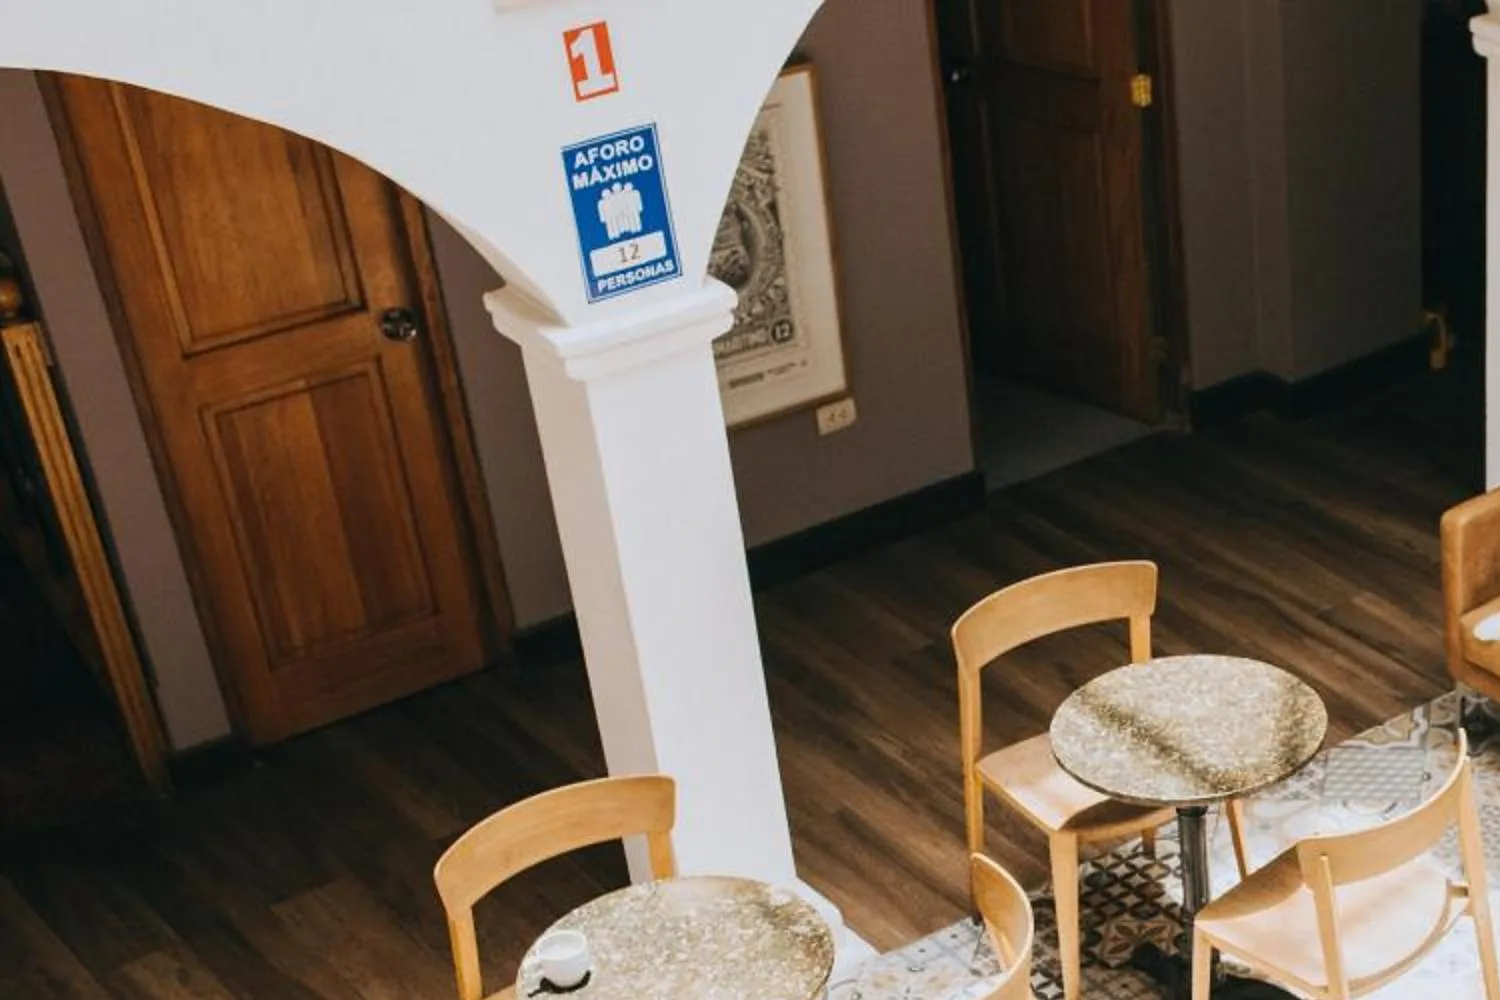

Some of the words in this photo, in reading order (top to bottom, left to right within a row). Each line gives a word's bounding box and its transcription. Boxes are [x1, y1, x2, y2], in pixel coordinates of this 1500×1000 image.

[569, 26, 616, 98] 1
[573, 135, 645, 169] AFORO
[571, 154, 654, 191] MÁXIMO
[617, 242, 641, 265] 12
[596, 259, 675, 293] PERSONAS
